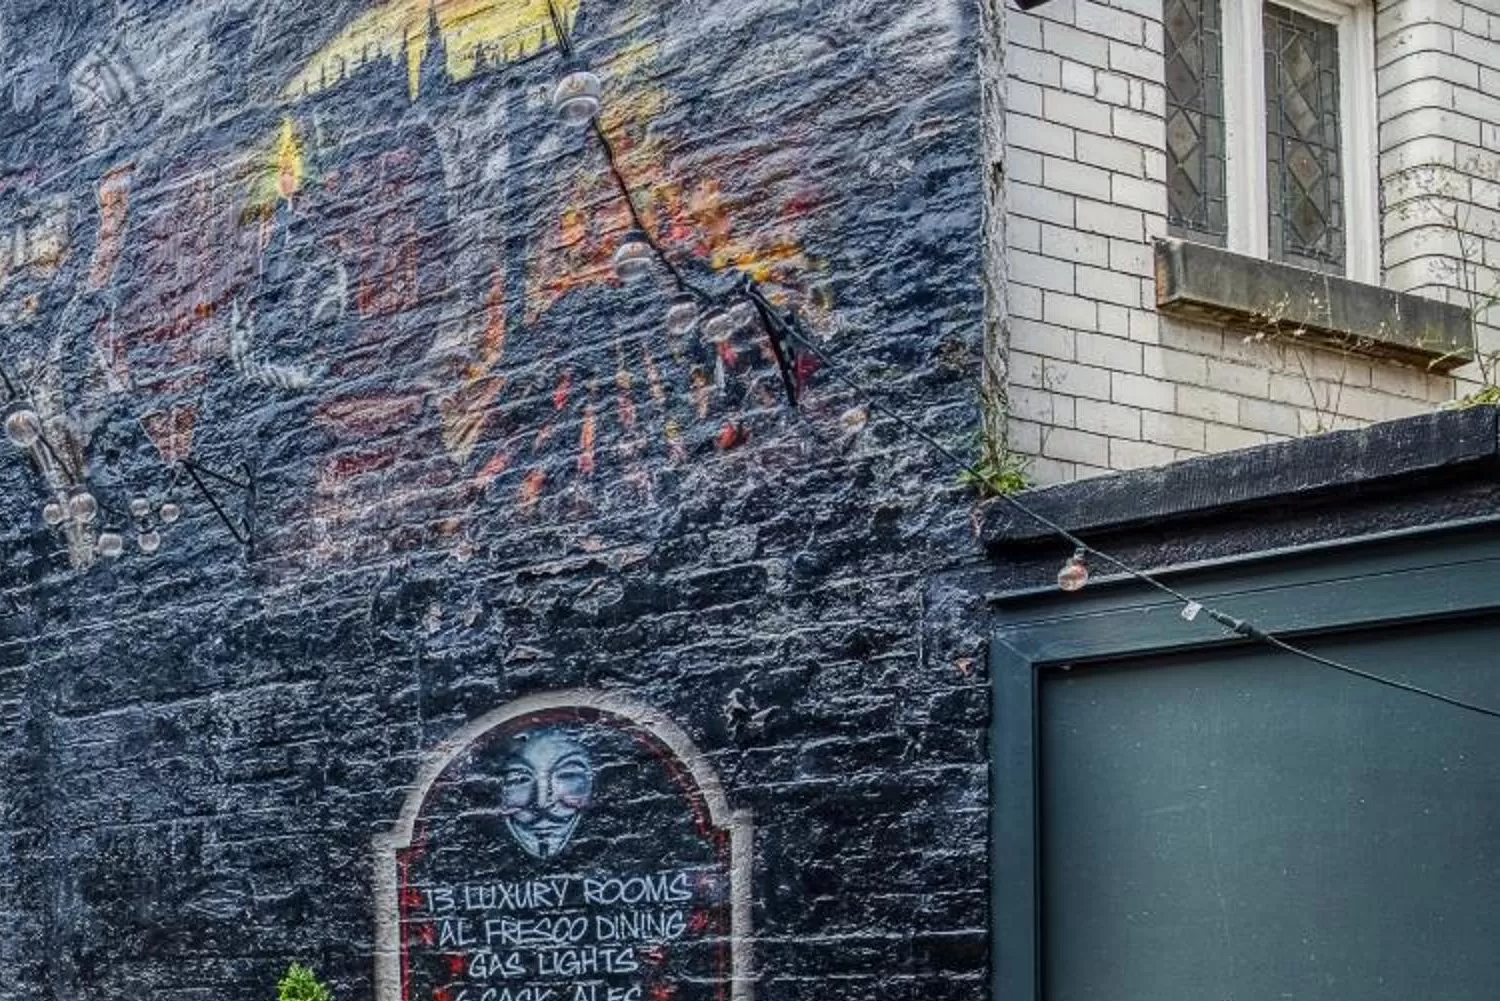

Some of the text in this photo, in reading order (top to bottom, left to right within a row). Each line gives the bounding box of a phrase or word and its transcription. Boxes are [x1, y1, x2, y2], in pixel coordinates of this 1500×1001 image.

[464, 878, 569, 911] LUXURY
[583, 874, 693, 903] ROOMS
[439, 910, 687, 946] AL FRESCO DINING
[468, 948, 639, 980] GAS LIGHTS
